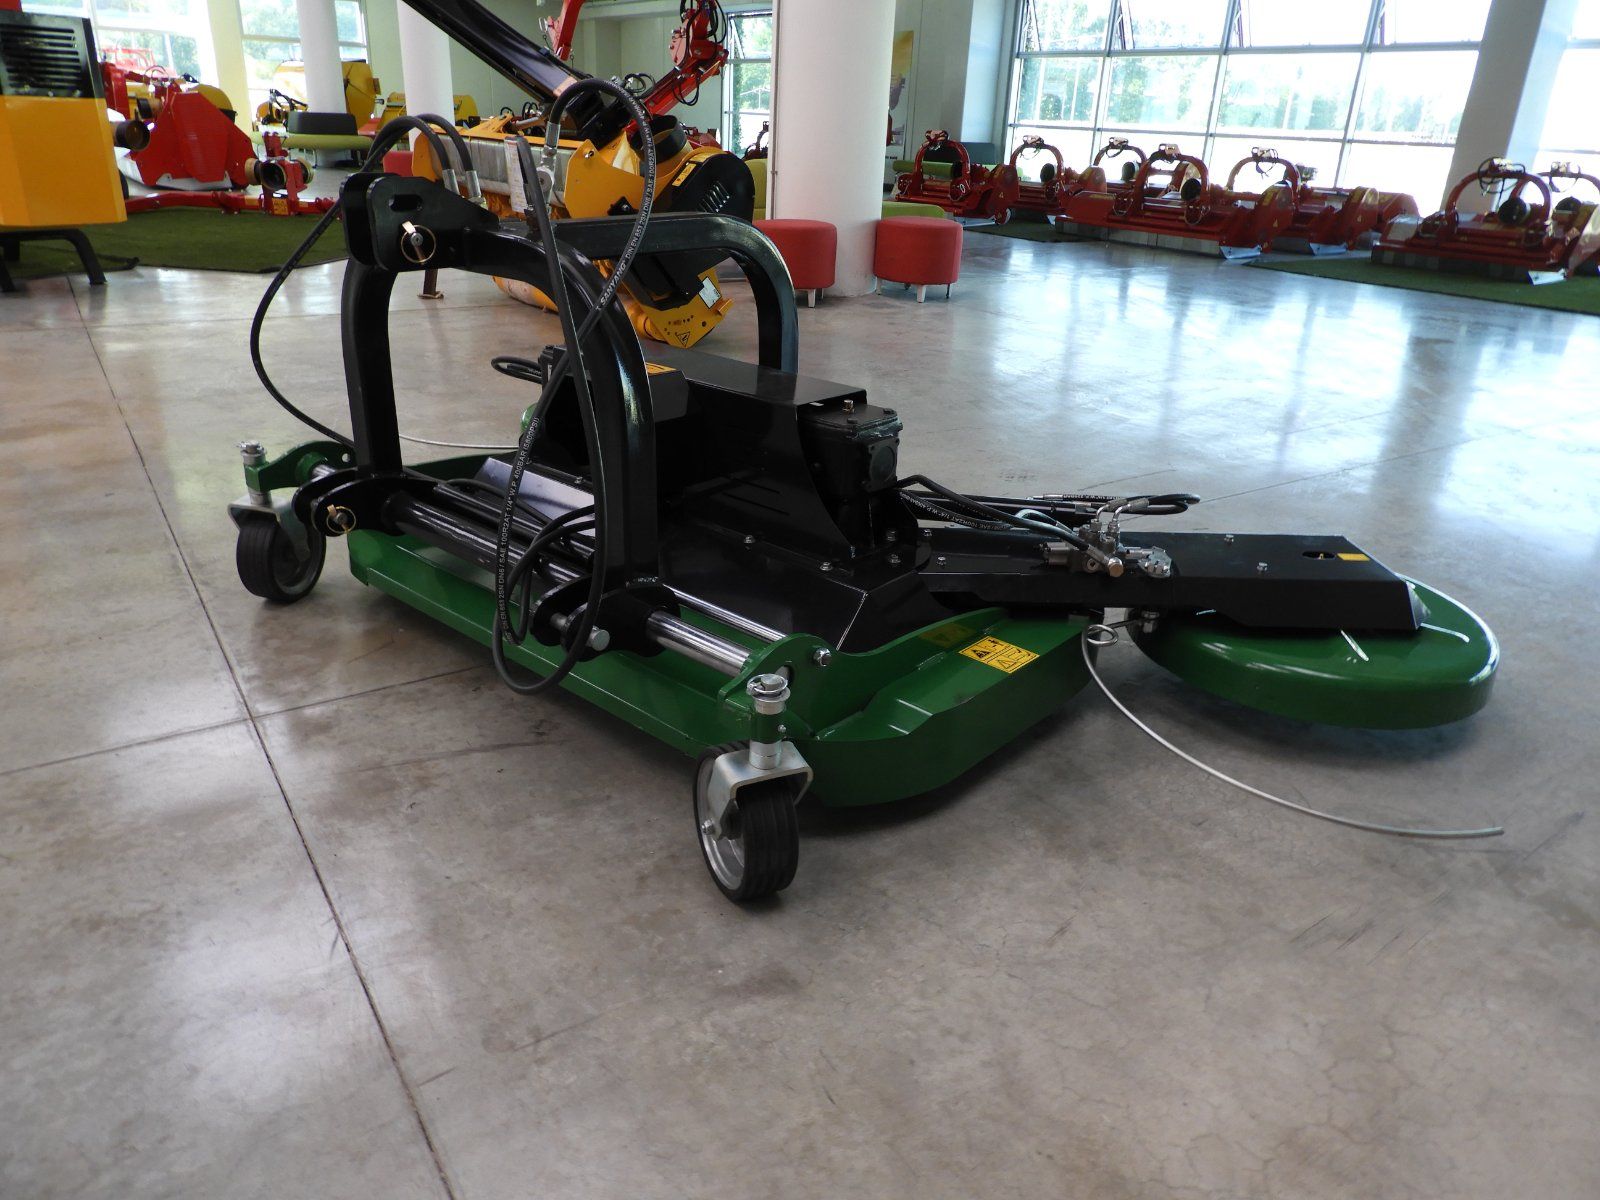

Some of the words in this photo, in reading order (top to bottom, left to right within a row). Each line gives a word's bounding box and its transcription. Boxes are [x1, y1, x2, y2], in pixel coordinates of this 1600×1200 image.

[600, 262, 626, 305] SANYANG
[625, 246, 635, 259] DIN
[630, 237, 639, 247] EN
[501, 512, 511, 545] 100R2AT
[514, 450, 527, 479] 400BAR
